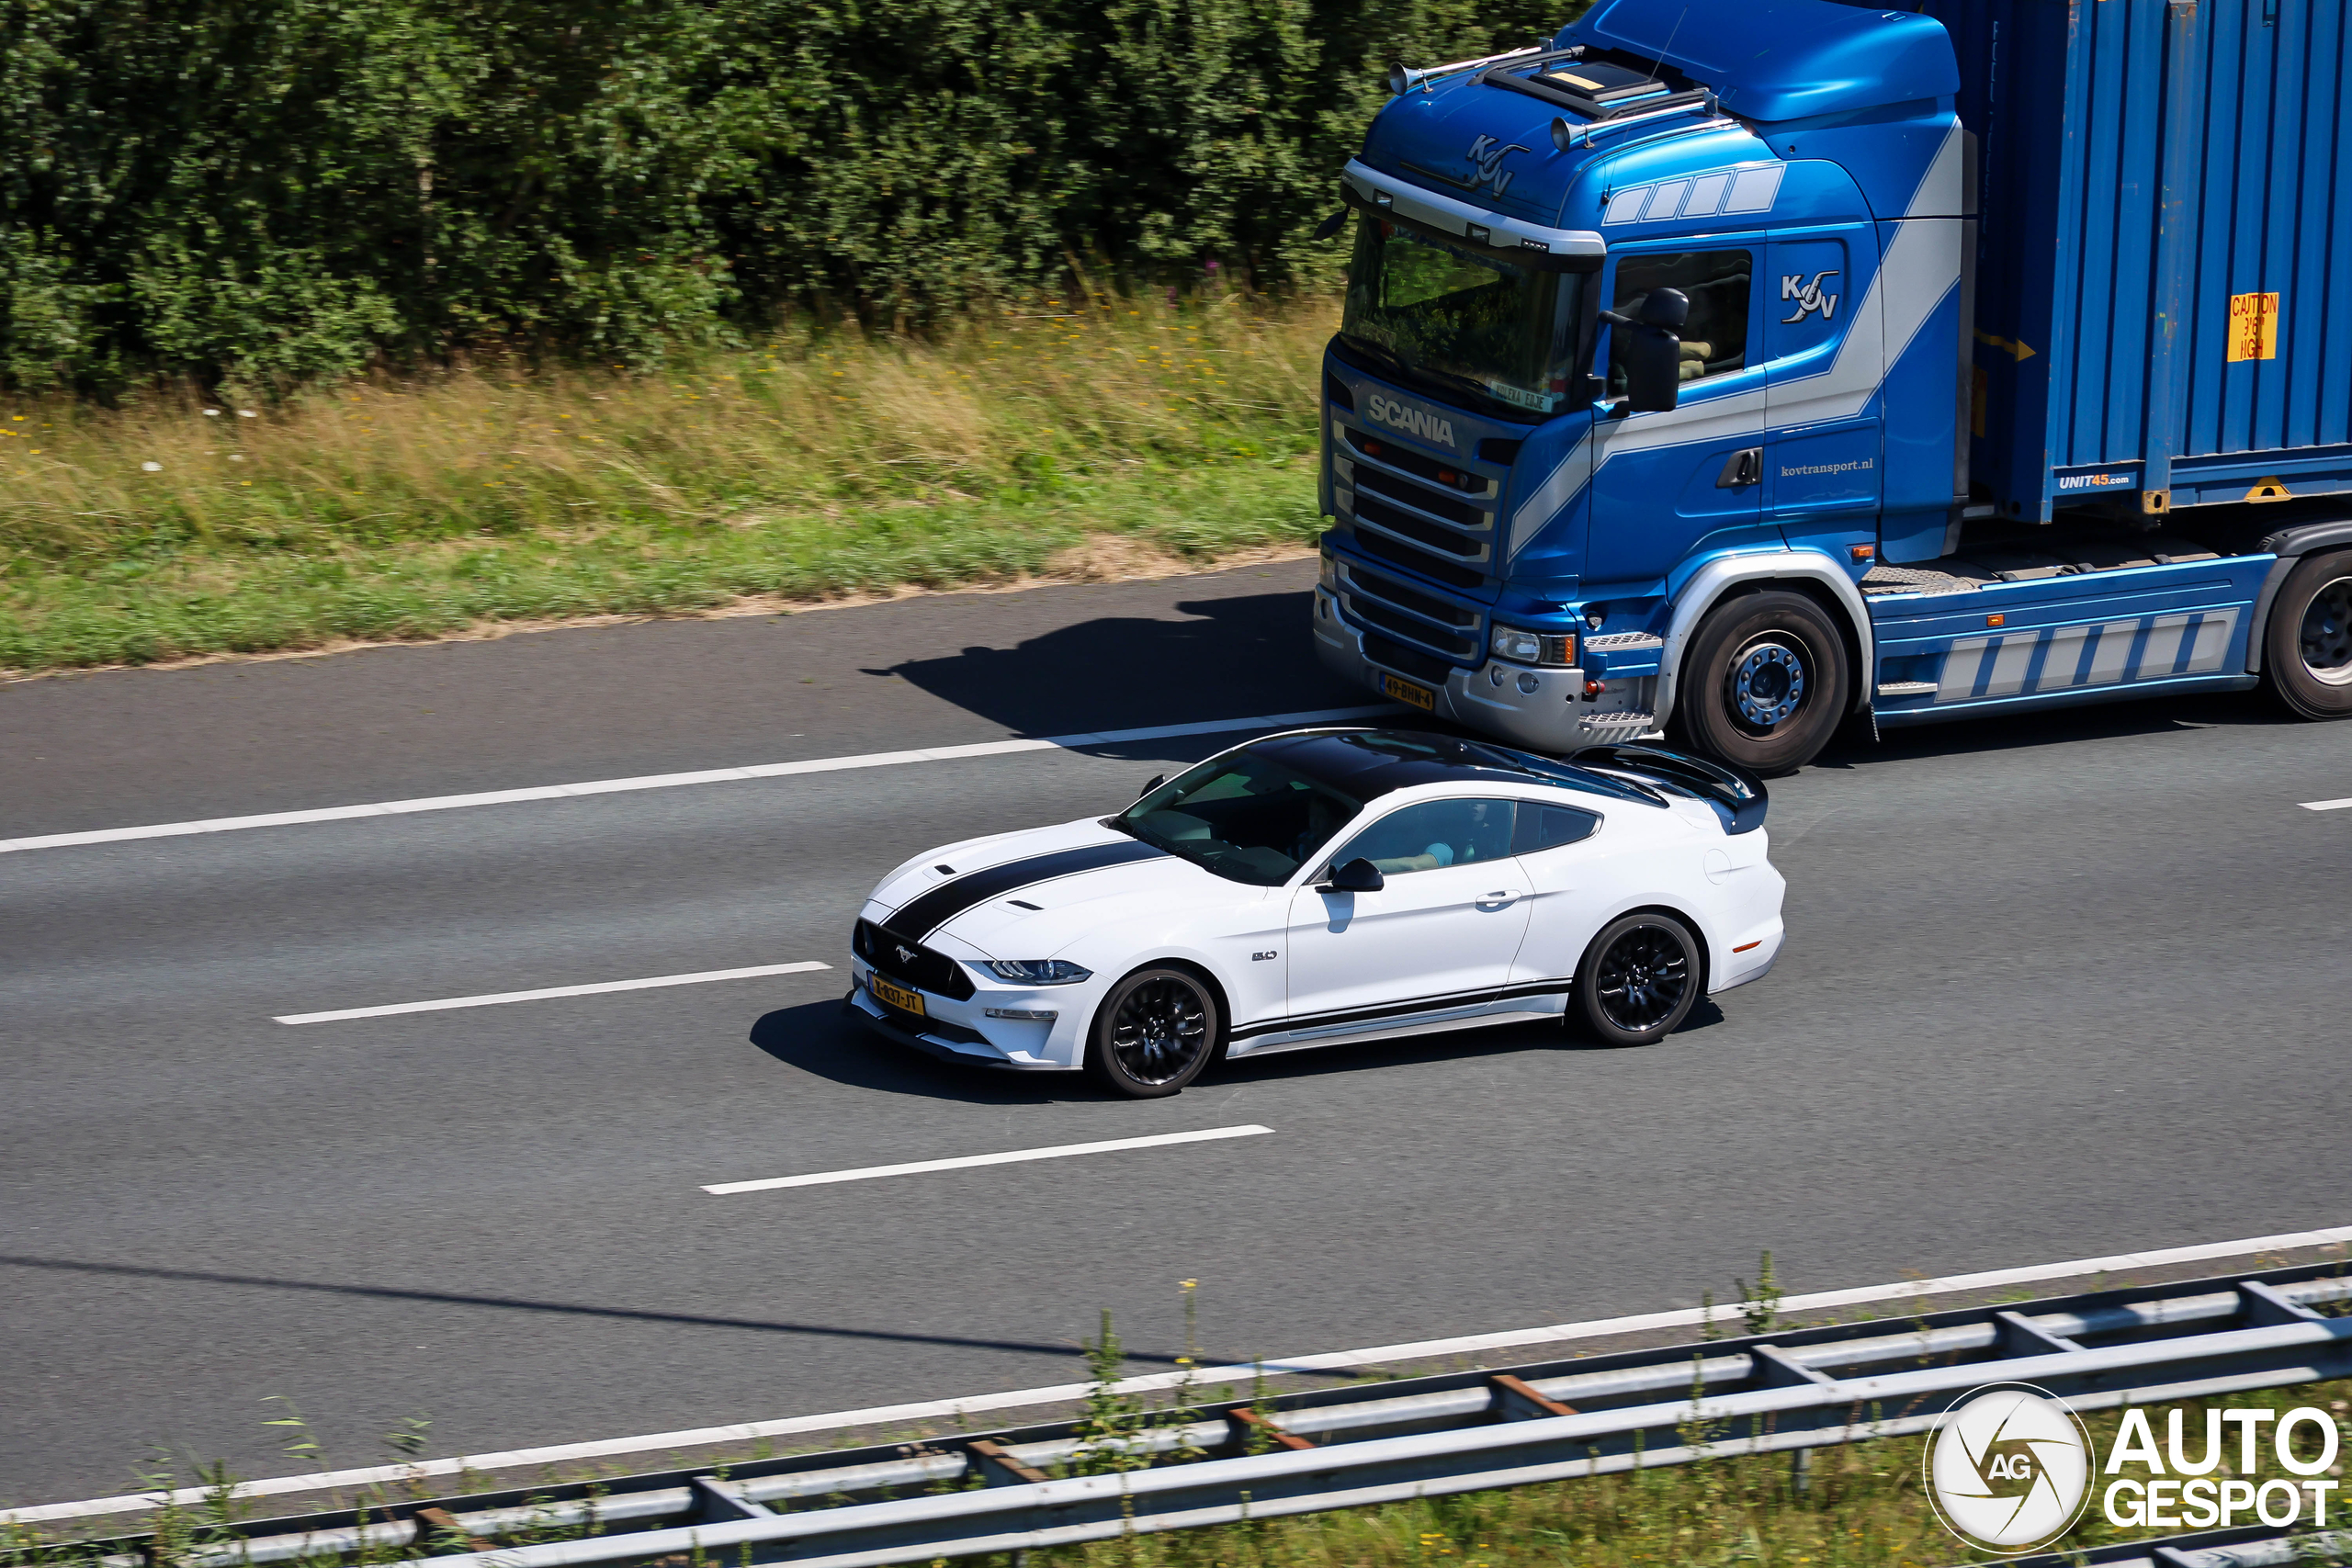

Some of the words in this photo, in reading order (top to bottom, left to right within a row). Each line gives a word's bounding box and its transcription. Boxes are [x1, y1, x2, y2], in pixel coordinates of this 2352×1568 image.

[1368, 394, 1455, 447] SCANIA
[1781, 458, 1873, 477] kovtransport.nl
[2059, 474, 2129, 489] UNIT45.com
[1386, 679, 1430, 707] 49-BHN-4
